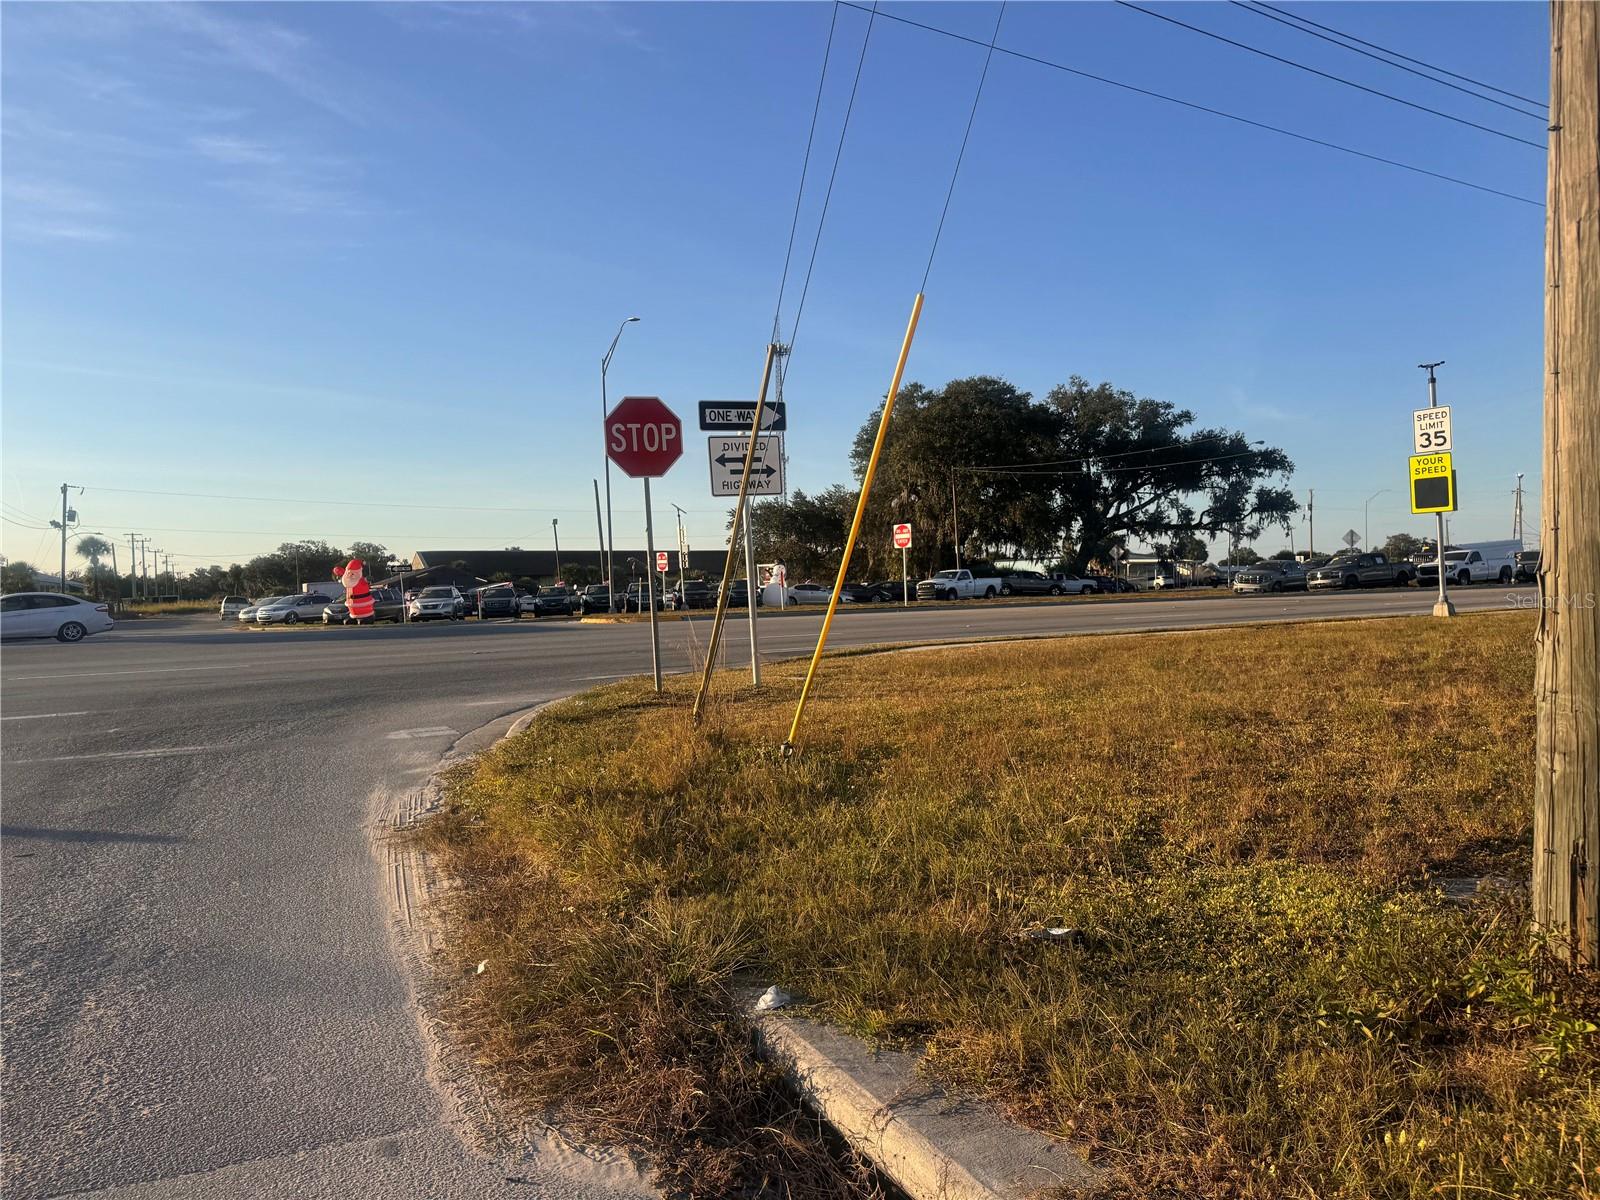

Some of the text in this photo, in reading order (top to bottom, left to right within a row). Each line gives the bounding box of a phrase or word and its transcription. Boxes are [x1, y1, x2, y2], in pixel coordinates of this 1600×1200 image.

[709, 410, 732, 421] ONE
[1416, 411, 1447, 421] SPEED
[1419, 421, 1444, 431] LIMIT
[611, 423, 677, 453] STOP
[1419, 430, 1447, 448] 35
[722, 442, 766, 451] DIVIDD
[1416, 456, 1444, 466] YOUR
[1414, 465, 1447, 475] SPEED
[722, 480, 771, 490] HIGWAY
